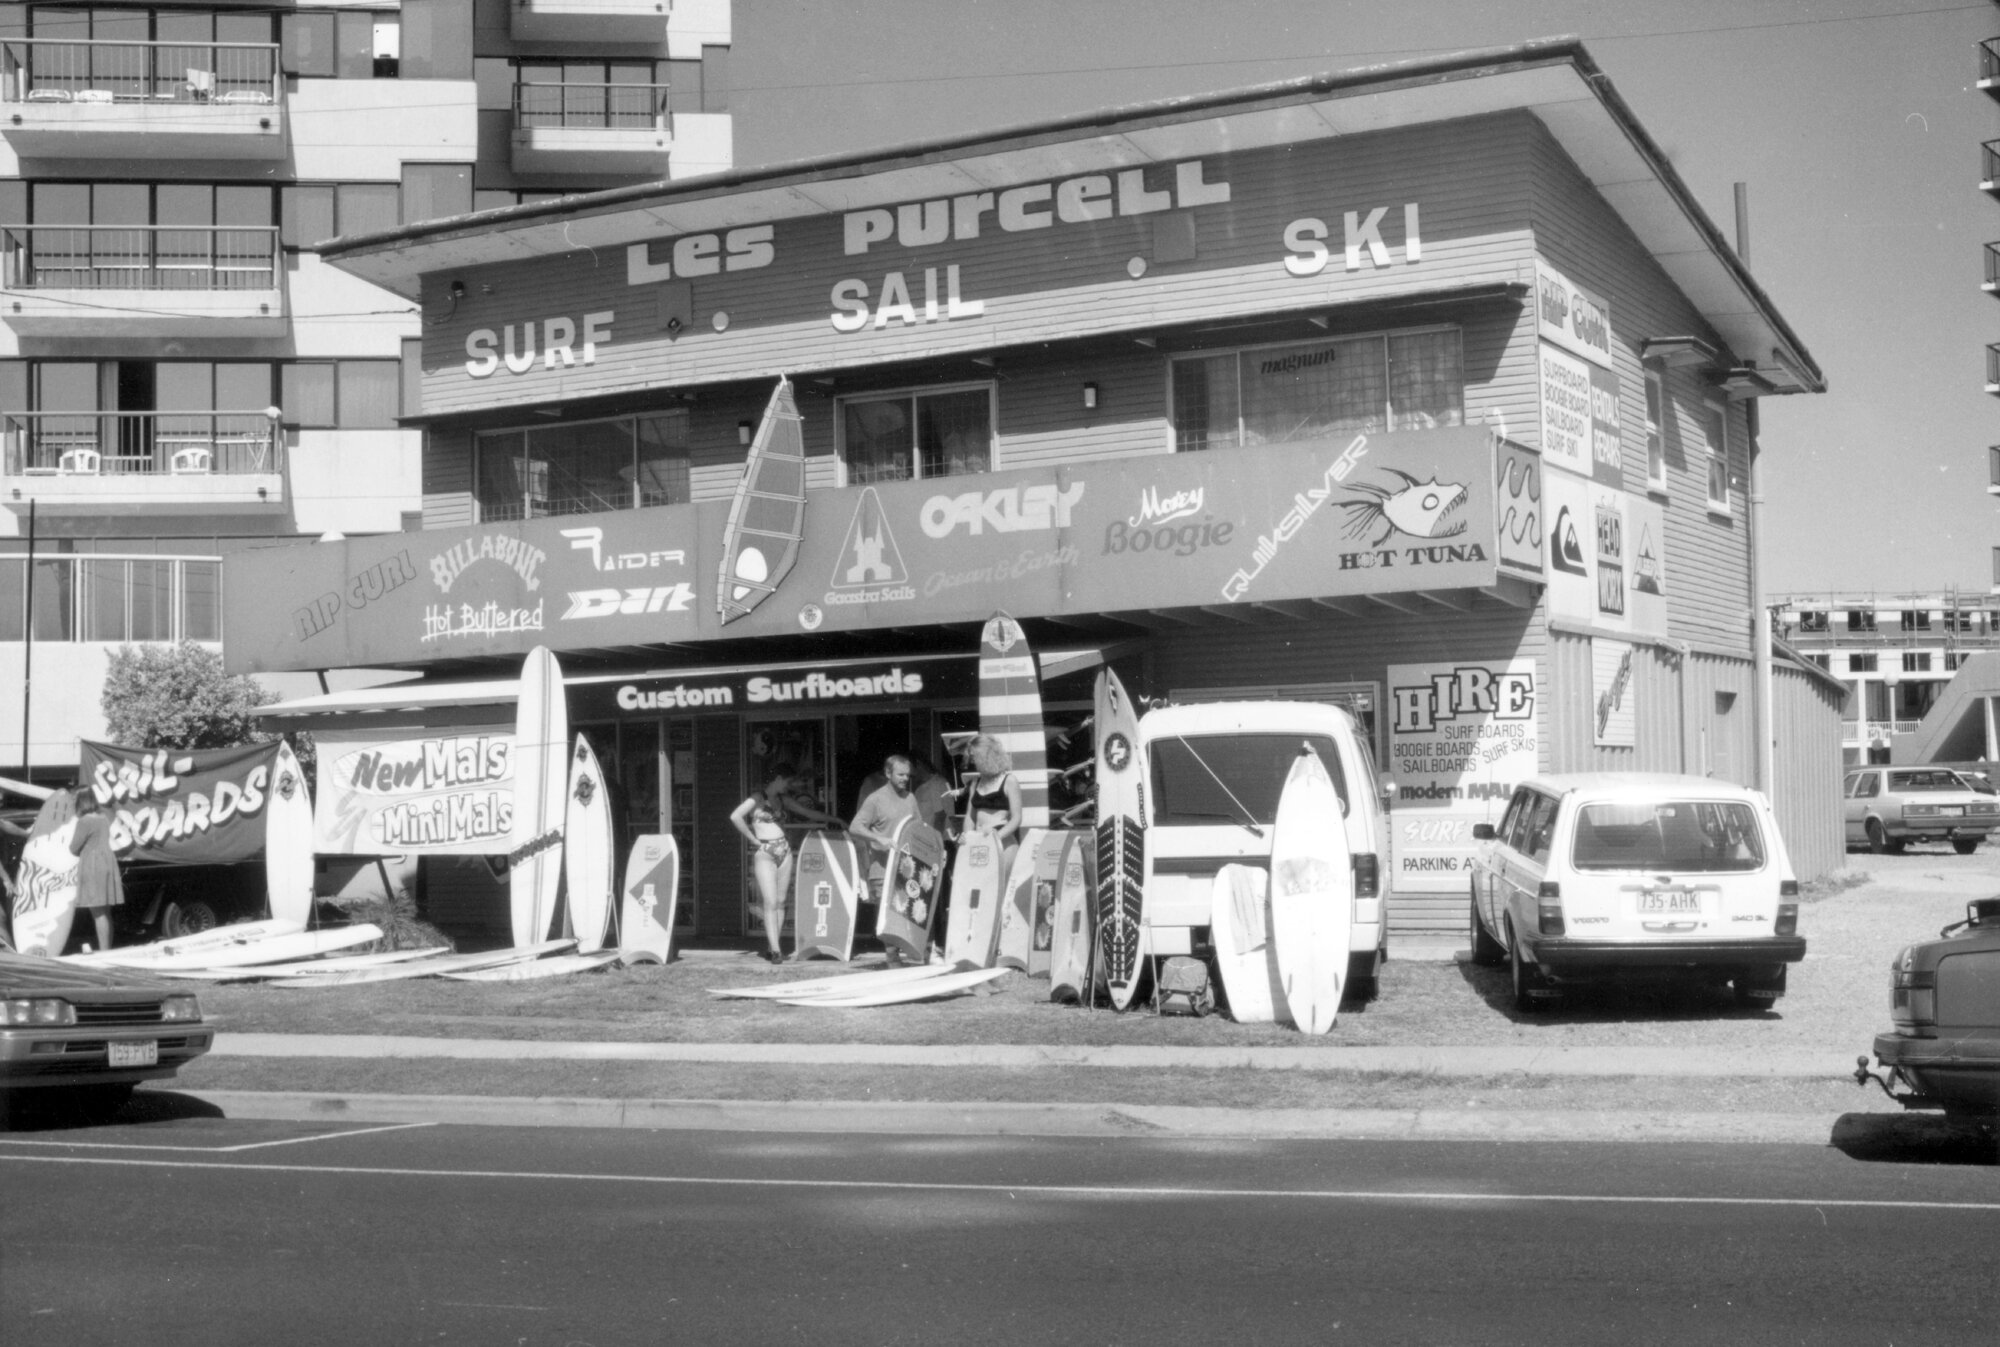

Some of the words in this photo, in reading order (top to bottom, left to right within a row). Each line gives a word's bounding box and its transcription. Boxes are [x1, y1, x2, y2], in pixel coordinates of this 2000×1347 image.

[1283, 202, 1421, 277] SKI
[830, 263, 985, 333] SAIL
[1541, 273, 1568, 329] RIP
[464, 310, 615, 379] SURF
[1260, 347, 1336, 374] magnum
[1543, 358, 1588, 395] SURFBOARD
[1545, 405, 1584, 438] SAILBOARD
[1546, 429, 1565, 453] SURF
[920, 481, 1085, 539] OAKLEY
[1101, 514, 1235, 557] Boogie
[1597, 512, 1620, 558] HEAD
[430, 533, 547, 593] BILLABONG
[1339, 550, 1397, 571] HOT
[1405, 543, 1488, 566] TUNA
[881, 586, 917, 602] Sails
[422, 604, 456, 642] Hot
[459, 597, 544, 639] Buttered
[617, 684, 733, 711] Custom
[747, 668, 924, 703] Surfboards
[1393, 666, 1535, 735] HIRE
[1394, 741, 1434, 758] BOOGIE
[1436, 741, 1481, 757] BOARDS
[1444, 725, 1475, 740] SURF
[1478, 723, 1526, 739] BOARDS
[1482, 741, 1510, 765] SURF
[1511, 738, 1537, 752] SKIS
[351, 751, 424, 792] New
[421, 735, 508, 790] Mals
[1403, 757, 1478, 774] SAILBOARDS
[109, 765, 268, 852] BOARDS
[1401, 781, 1464, 800] modern
[382, 799, 446, 845] Mini
[447, 791, 512, 842] Mals
[1403, 820, 1466, 842] SURF
[1403, 857, 1458, 872] PARKING
